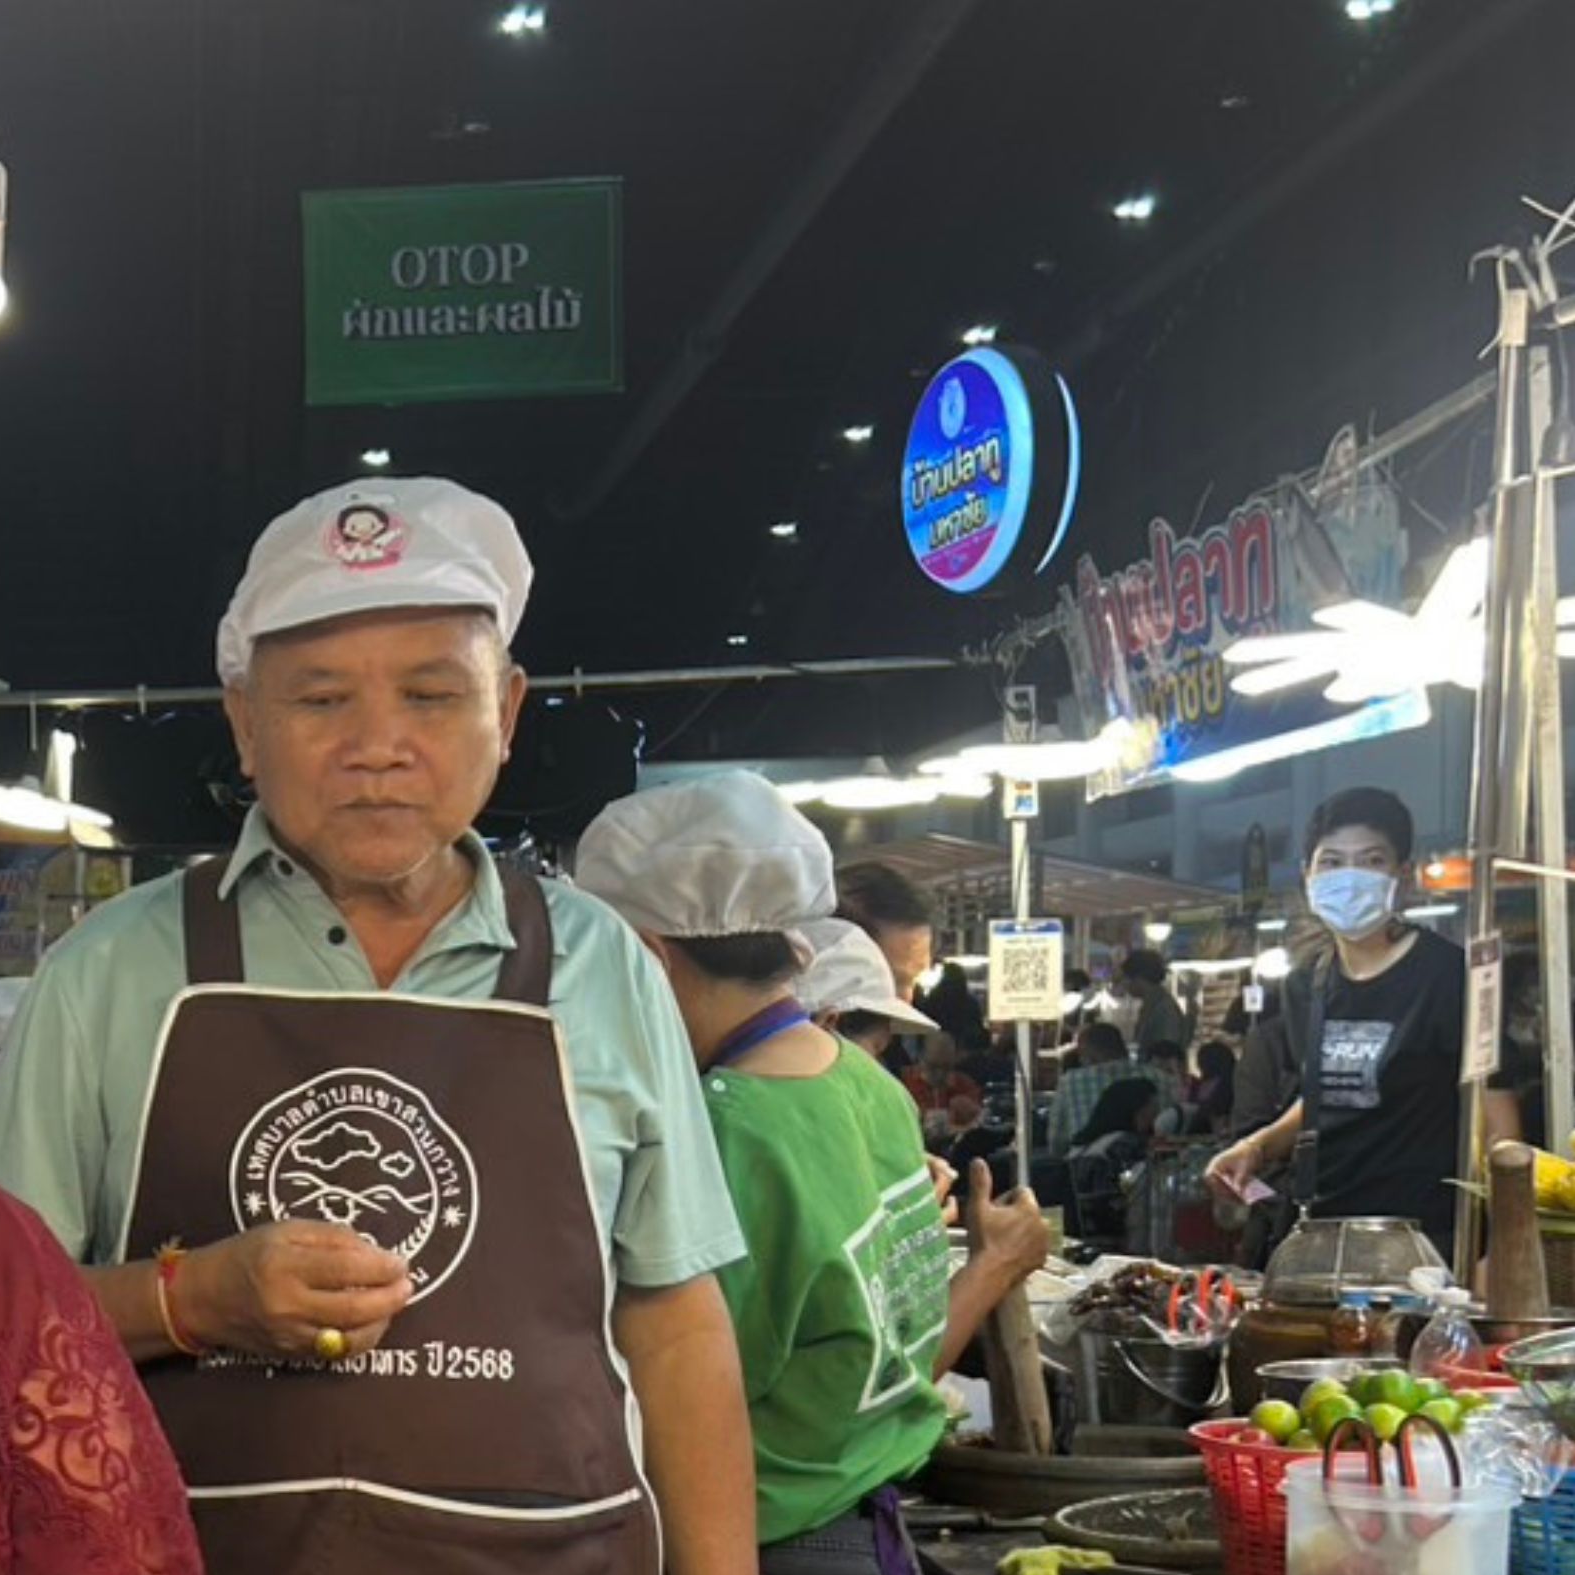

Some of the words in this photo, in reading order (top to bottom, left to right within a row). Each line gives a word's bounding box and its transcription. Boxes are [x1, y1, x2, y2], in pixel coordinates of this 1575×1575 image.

[391, 242, 530, 288] OTOP
[342, 285, 583, 339] ผักและผลไม้
